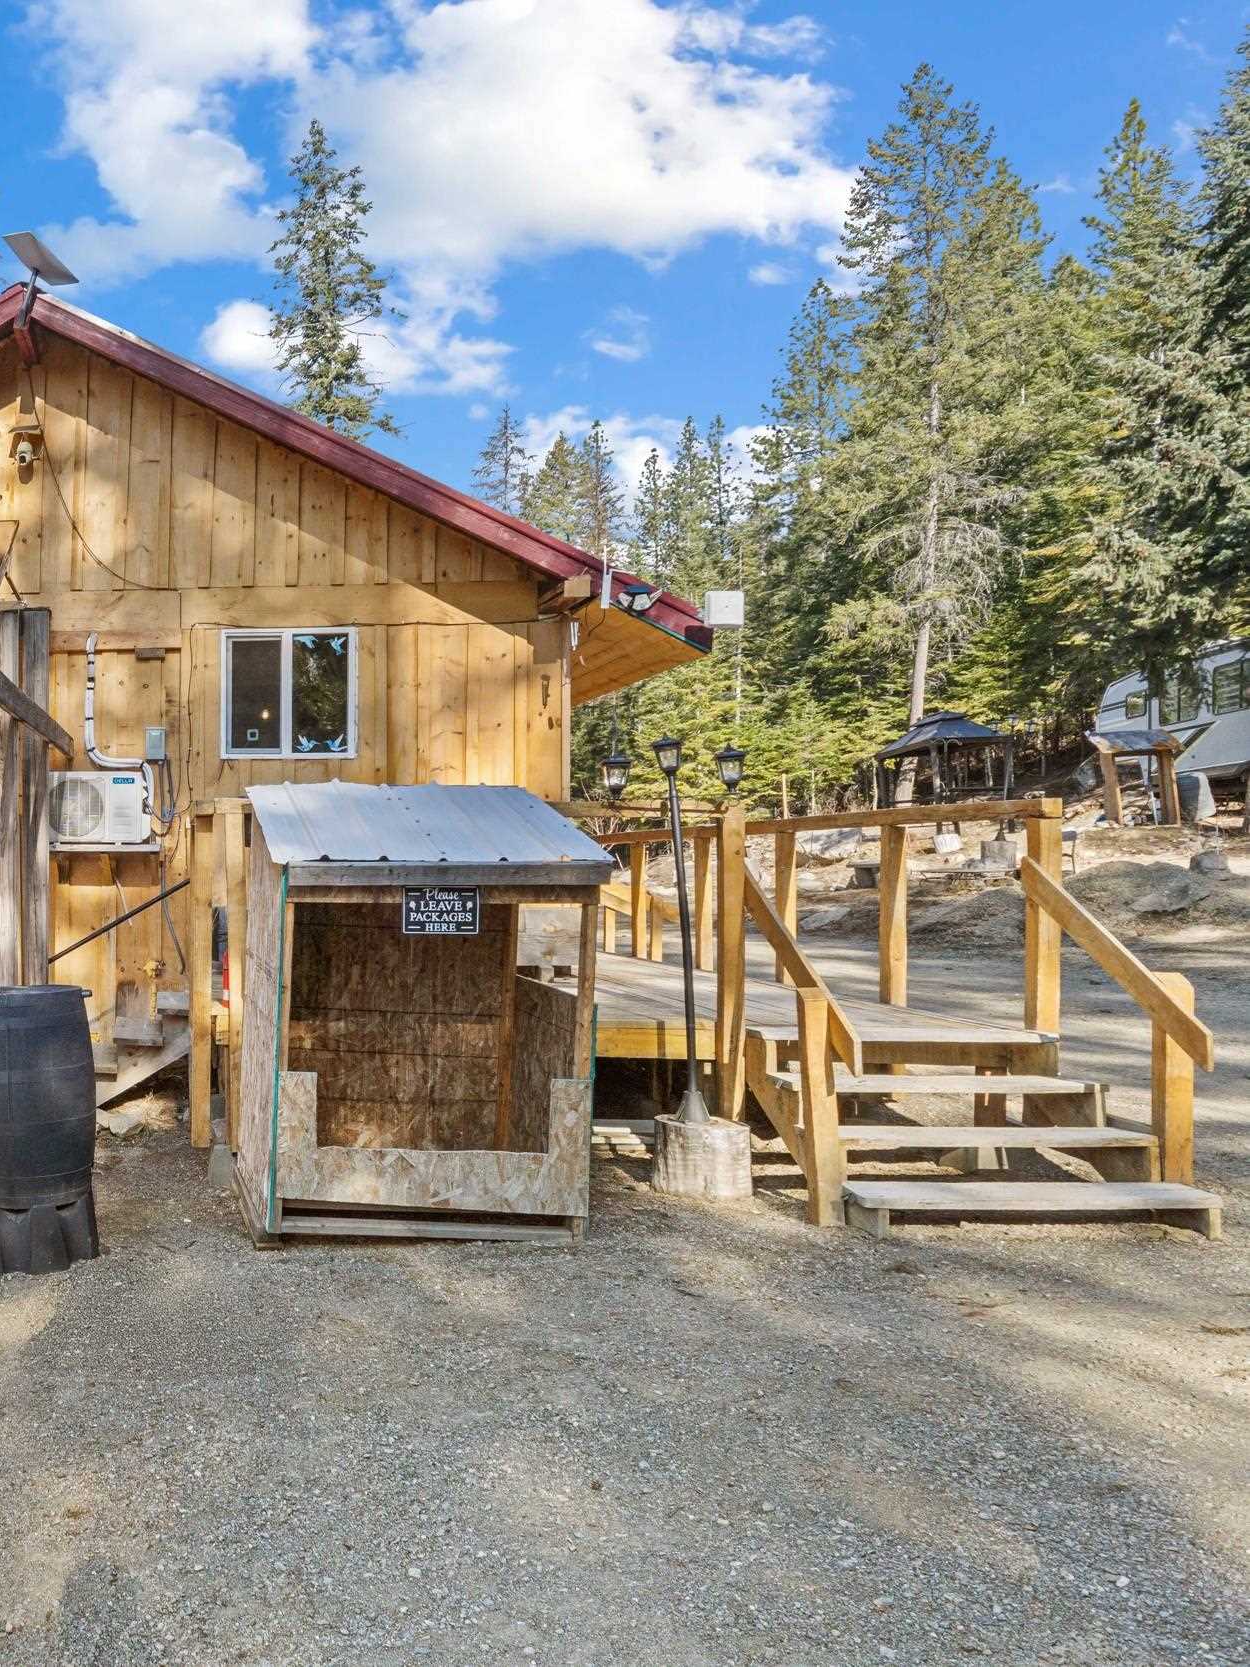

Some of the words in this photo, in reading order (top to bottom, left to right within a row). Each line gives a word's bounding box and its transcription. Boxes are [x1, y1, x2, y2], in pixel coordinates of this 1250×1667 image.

[423, 888, 460, 900] Please
[420, 900, 462, 911] LEAVE
[410, 912, 472, 921] PACKAGES
[425, 923, 456, 932] HERE
